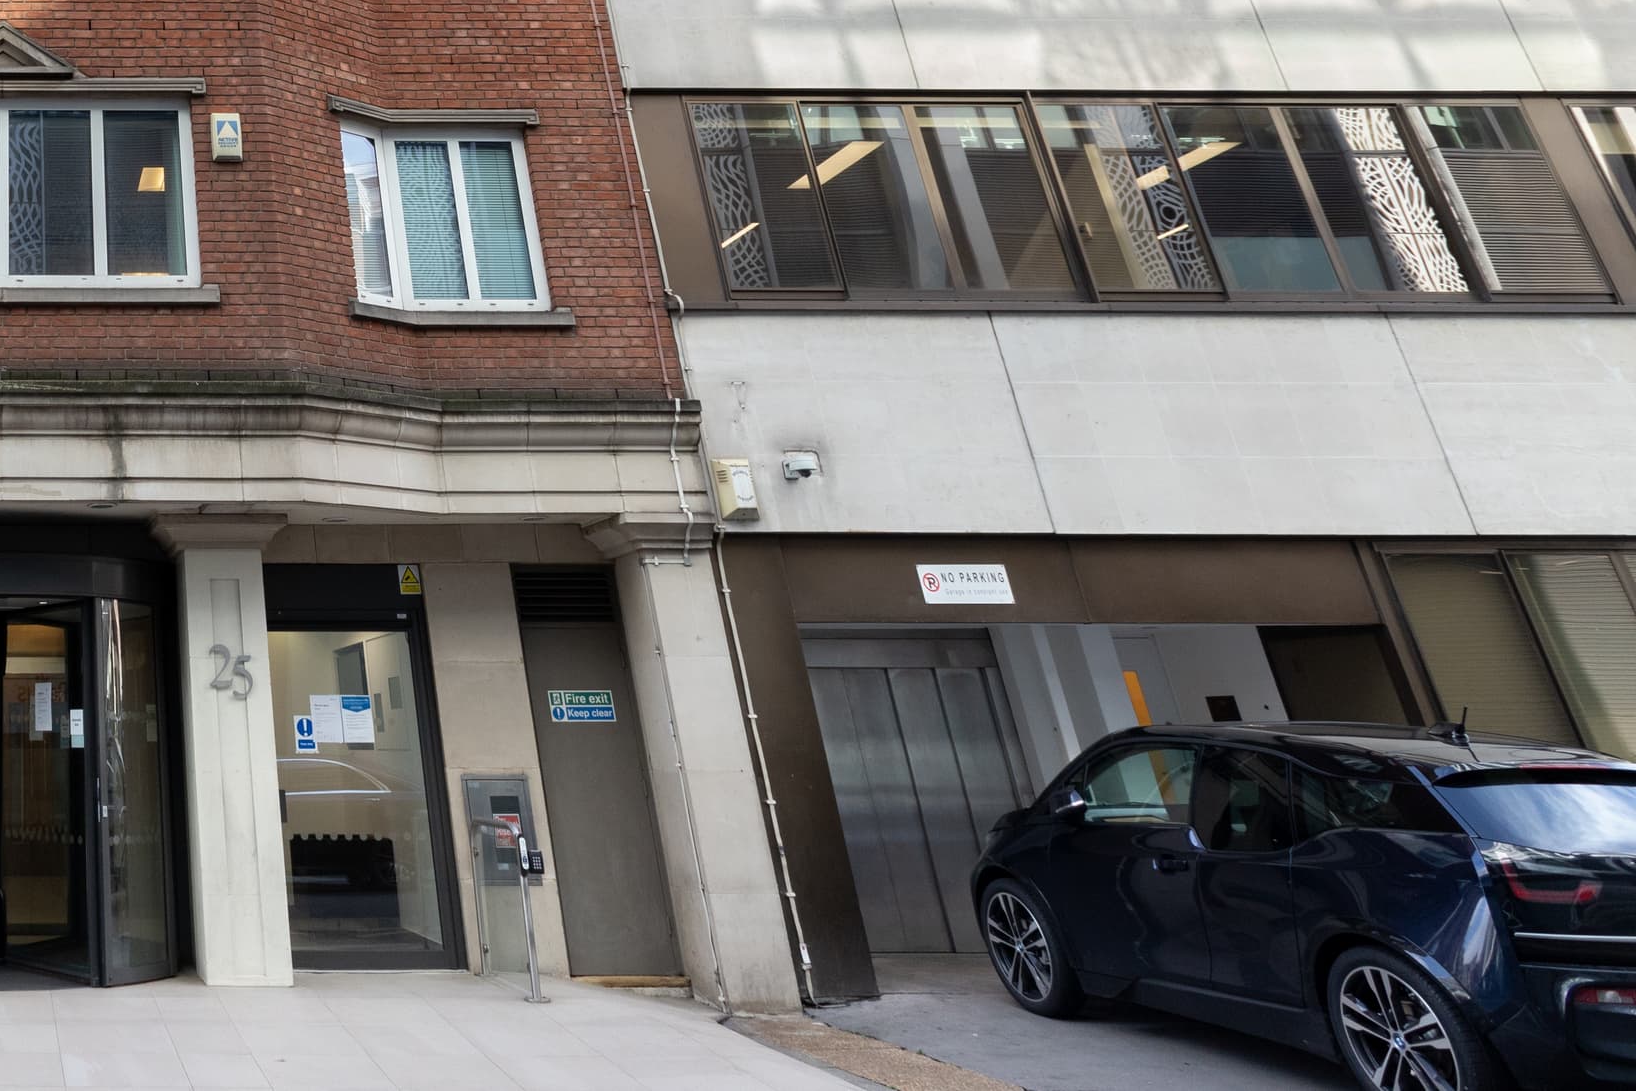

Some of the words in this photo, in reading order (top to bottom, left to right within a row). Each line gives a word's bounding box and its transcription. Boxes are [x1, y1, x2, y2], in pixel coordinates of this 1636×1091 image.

[940, 572, 955, 583] NO
[959, 572, 1005, 583] PARKING
[209, 644, 254, 701] 25
[565, 693, 586, 704] Fire
[588, 693, 610, 704] exit
[567, 708, 590, 719] Keep
[591, 709, 613, 718] clear
